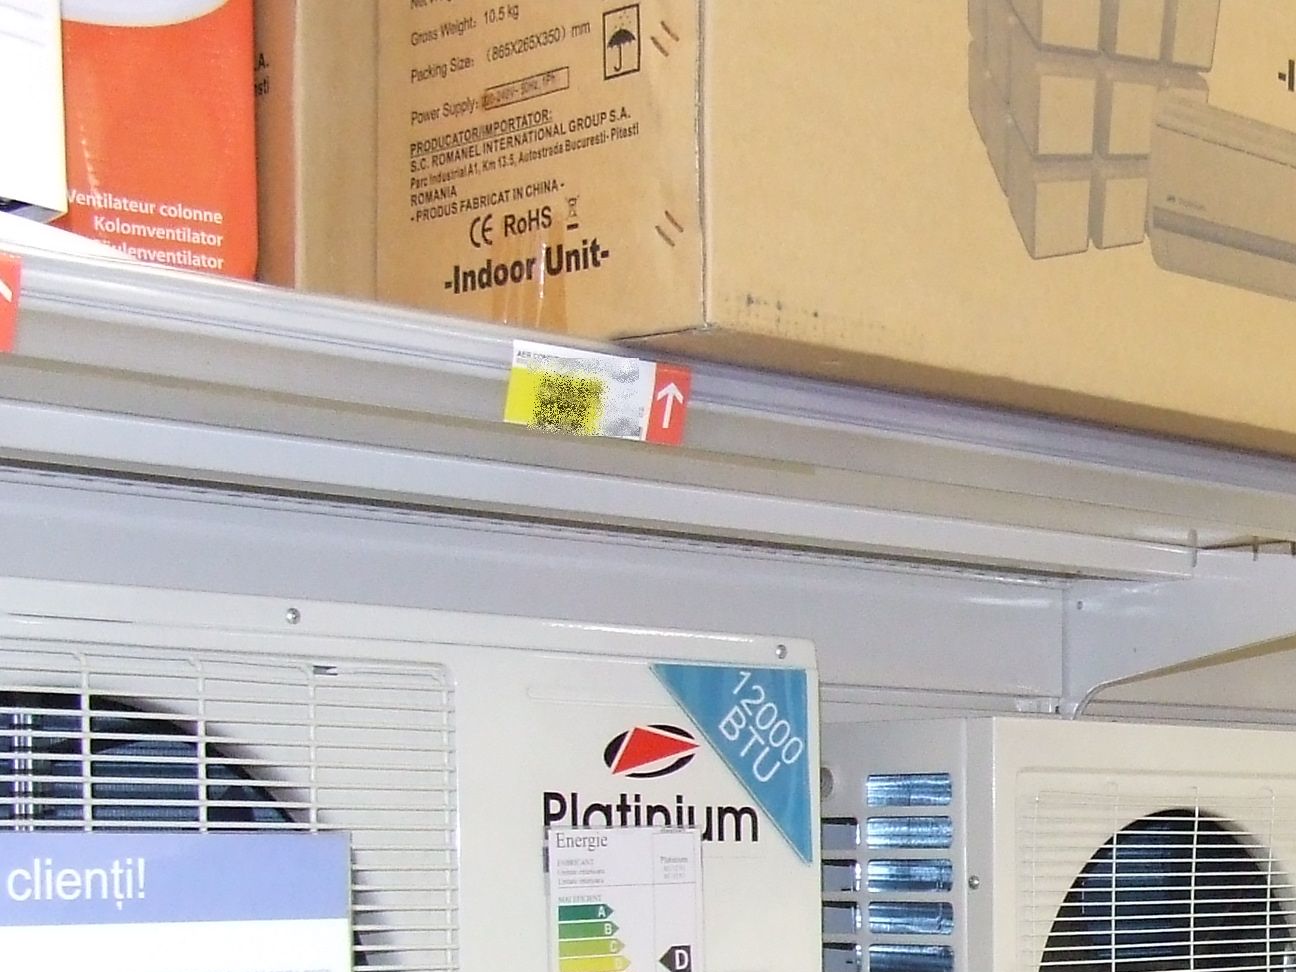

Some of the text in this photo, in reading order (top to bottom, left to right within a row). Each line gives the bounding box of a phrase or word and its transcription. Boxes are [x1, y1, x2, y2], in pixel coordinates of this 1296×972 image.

[411, 29, 438, 46] Gross
[484, 7, 505, 24] 10.5
[507, 4, 520, 20] kg
[411, 62, 447, 83] Packing
[571, 22, 591, 38] mm
[411, 109, 440, 126] Power
[410, 106, 631, 173] S.C. ROMANEL INTERNATIONAL GROUP S.A.
[410, 175, 428, 190] Parc
[482, 158, 497, 172] Km
[518, 141, 564, 164] Autostrada
[66, 188, 223, 224] Ventilateur colonne
[410, 185, 457, 207] ROMANIA
[459, 191, 511, 214] FABRICAT
[512, 187, 524, 201] IN
[93, 216, 223, 247] Kolomventilator
[504, 206, 553, 238] RoHS
[732, 671, 804, 765] 12000
[718, 705, 781, 783] BTU
[543, 791, 759, 842] Platinium
[556, 832, 608, 851] Energie
[6, 857, 146, 911] clienți!
[598, 906, 606, 917] A
[604, 923, 612, 935] B
[674, 949, 689, 970] D
